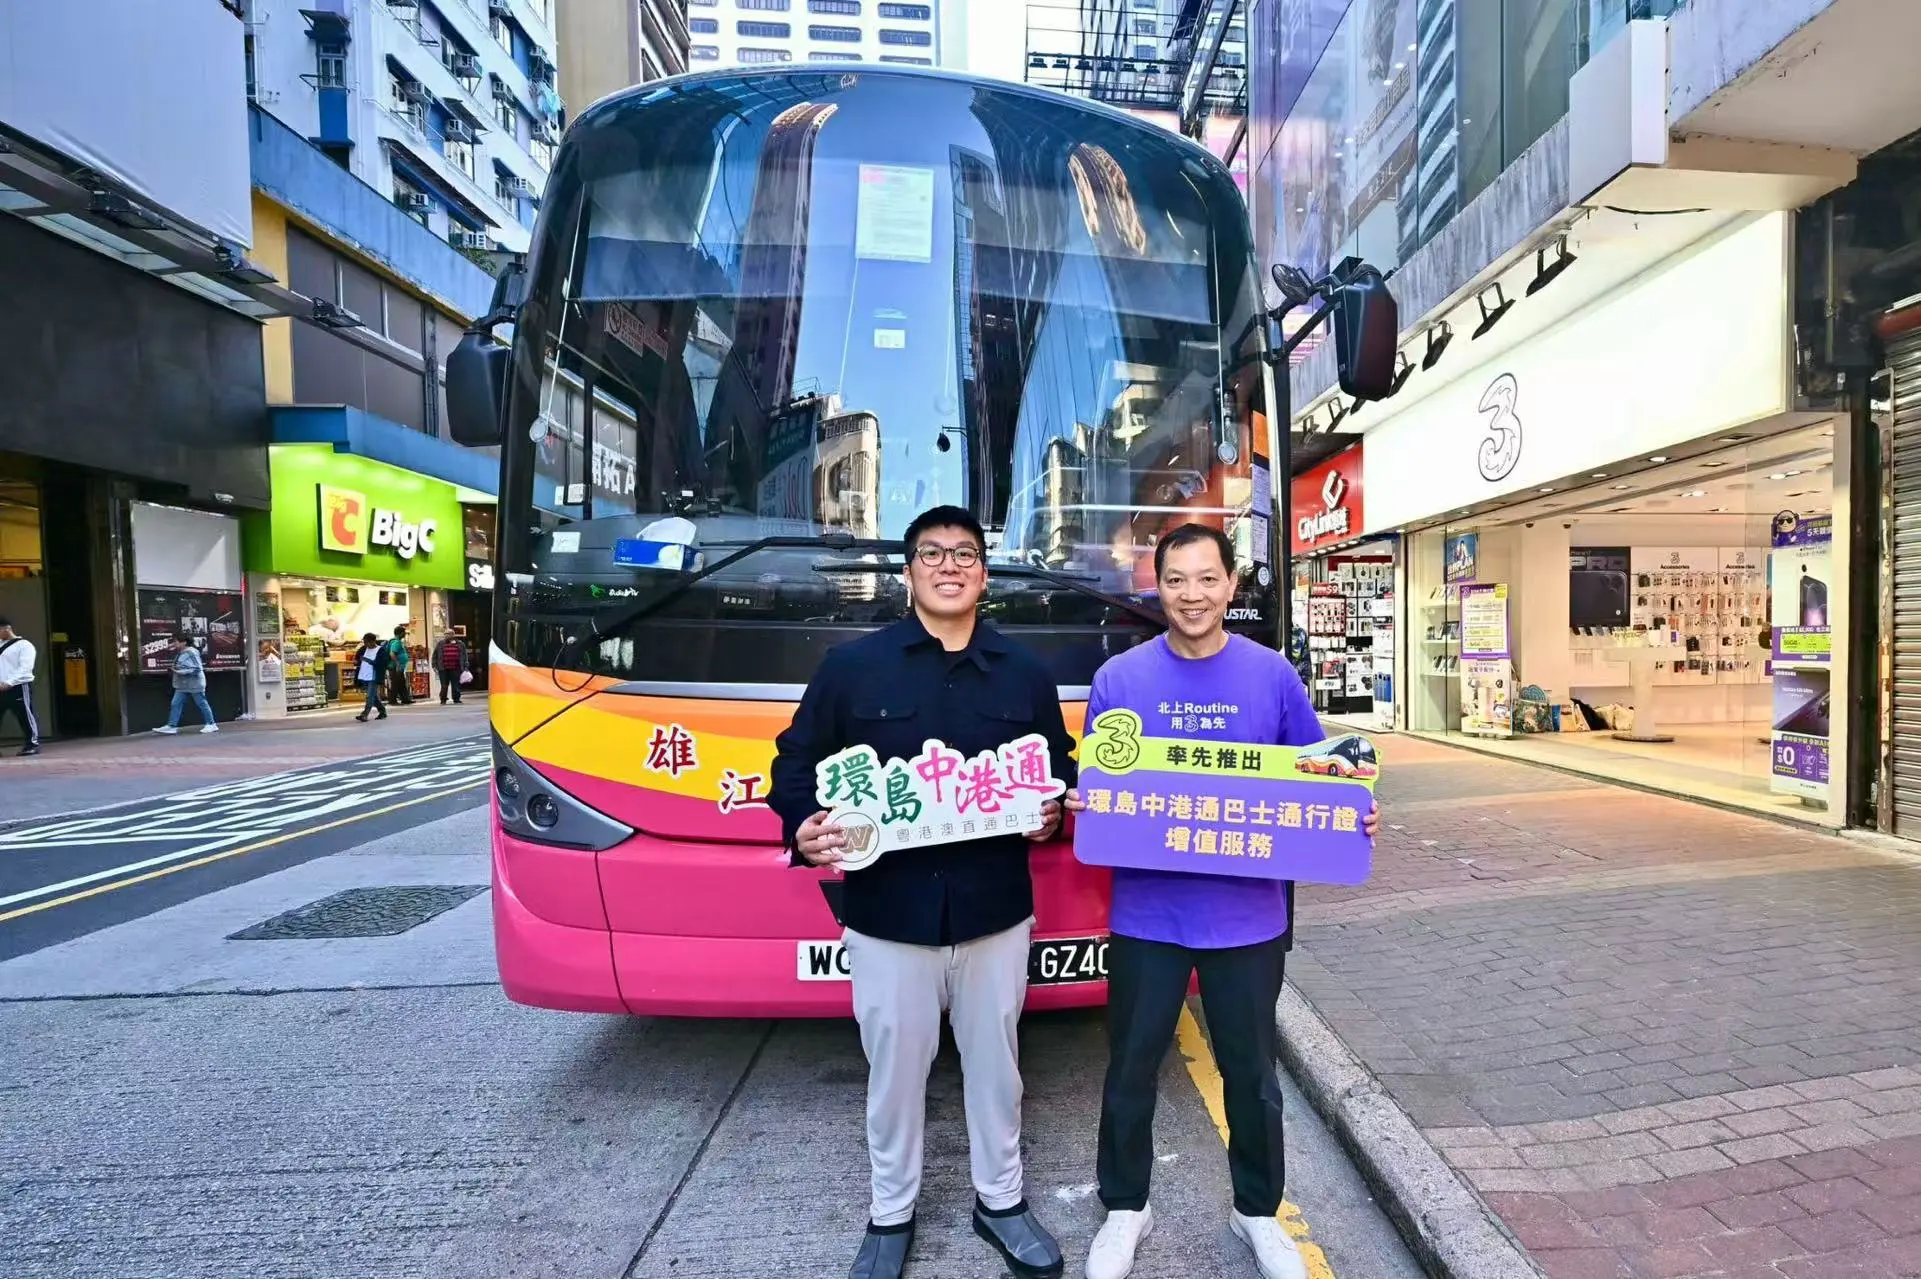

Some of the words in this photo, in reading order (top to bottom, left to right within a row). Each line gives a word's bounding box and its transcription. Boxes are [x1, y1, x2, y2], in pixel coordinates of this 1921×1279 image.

[372, 508, 436, 559] BigC
[1166, 744, 1262, 772] 率先推出
[825, 742, 1058, 826] 環島中港通
[896, 811, 1039, 843] 粵港澳直通巴士
[1087, 788, 1359, 832] 環島中港通巴士通行證
[1165, 828, 1273, 859] 增值服務
